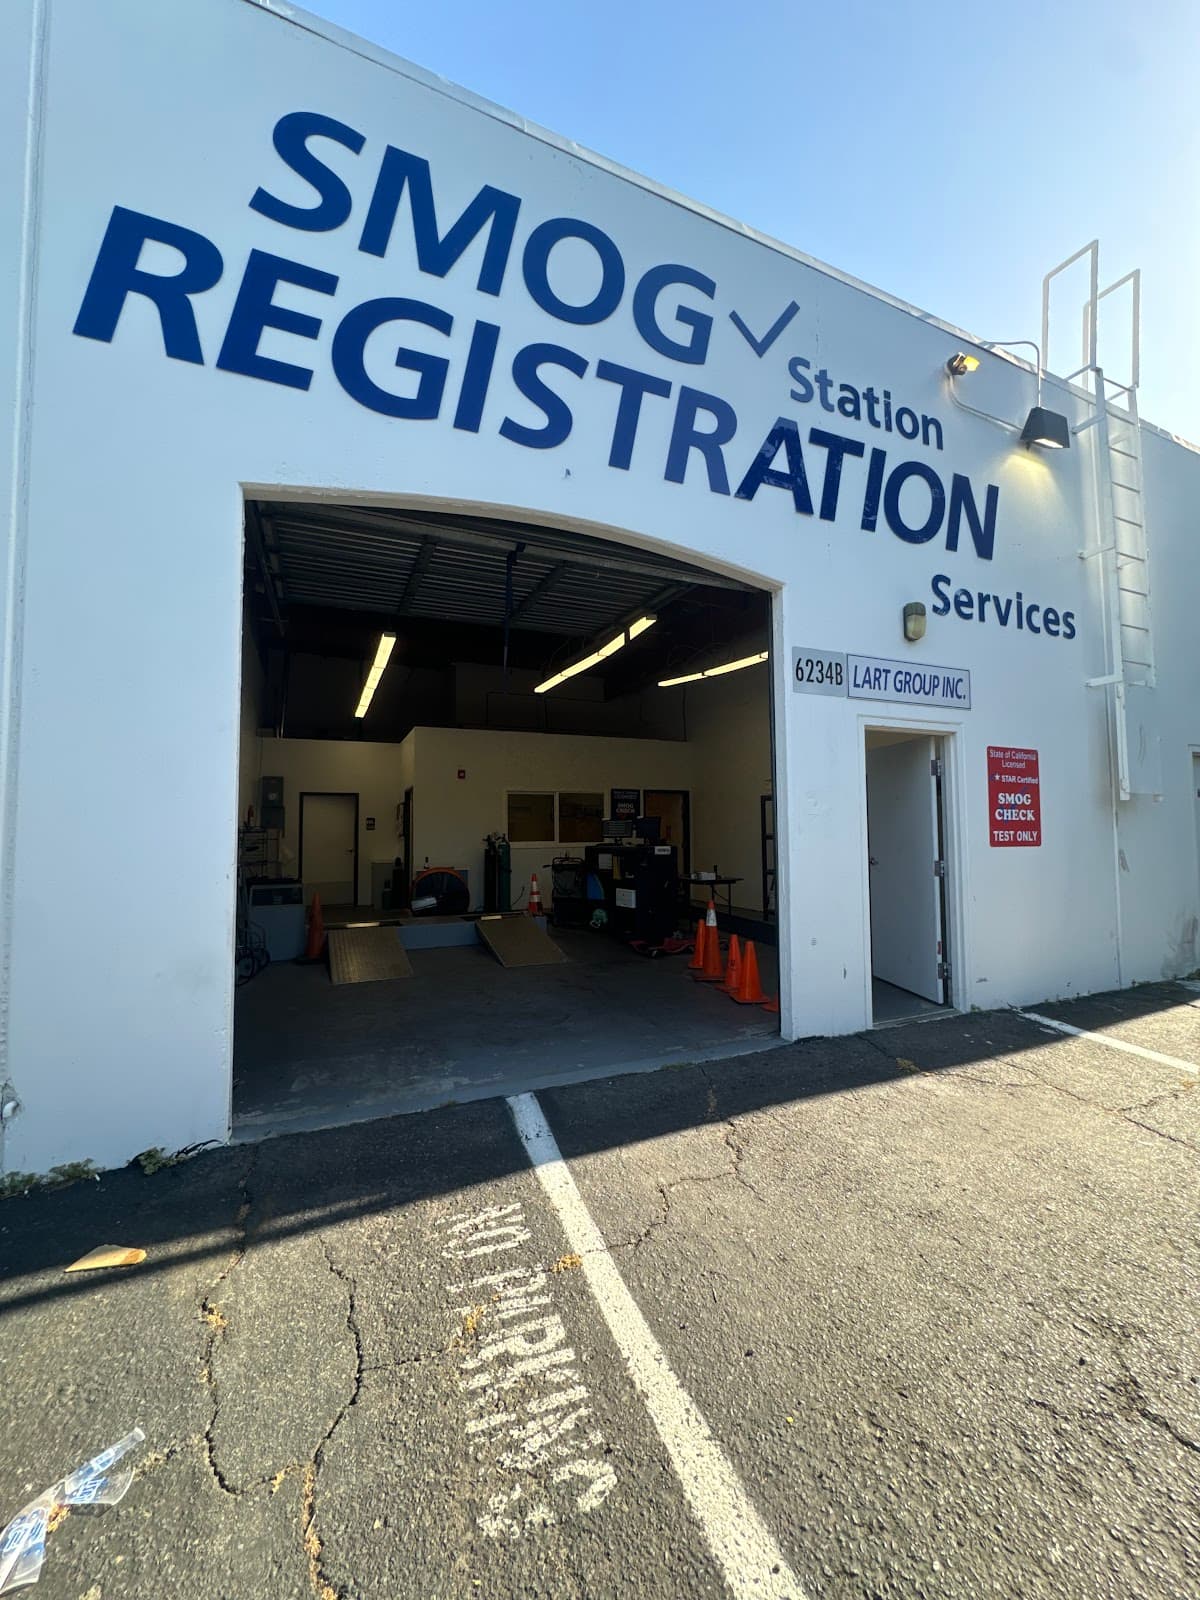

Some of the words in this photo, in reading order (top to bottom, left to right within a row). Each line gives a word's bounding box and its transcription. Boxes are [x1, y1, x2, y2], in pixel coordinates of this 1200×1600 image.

[249, 111, 717, 365] SMOG
[73, 204, 999, 561] REGISTRATION
[787, 356, 944, 450] Station
[931, 573, 1076, 640] Services
[795, 657, 844, 686] 6234B
[853, 664, 891, 691] LART
[893, 670, 940, 697] GROUP
[942, 676, 967, 700] INC.
[989, 749, 1004, 758] State
[1011, 751, 1036, 760] California
[1001, 760, 1026, 768] Licensed
[1001, 775, 1016, 783] STAR
[1017, 776, 1039, 784] Certified
[998, 792, 1032, 805] SMOG
[994, 809, 1036, 821] CHECK
[993, 830, 1015, 842] TEST
[1016, 831, 1038, 842] ONLY
